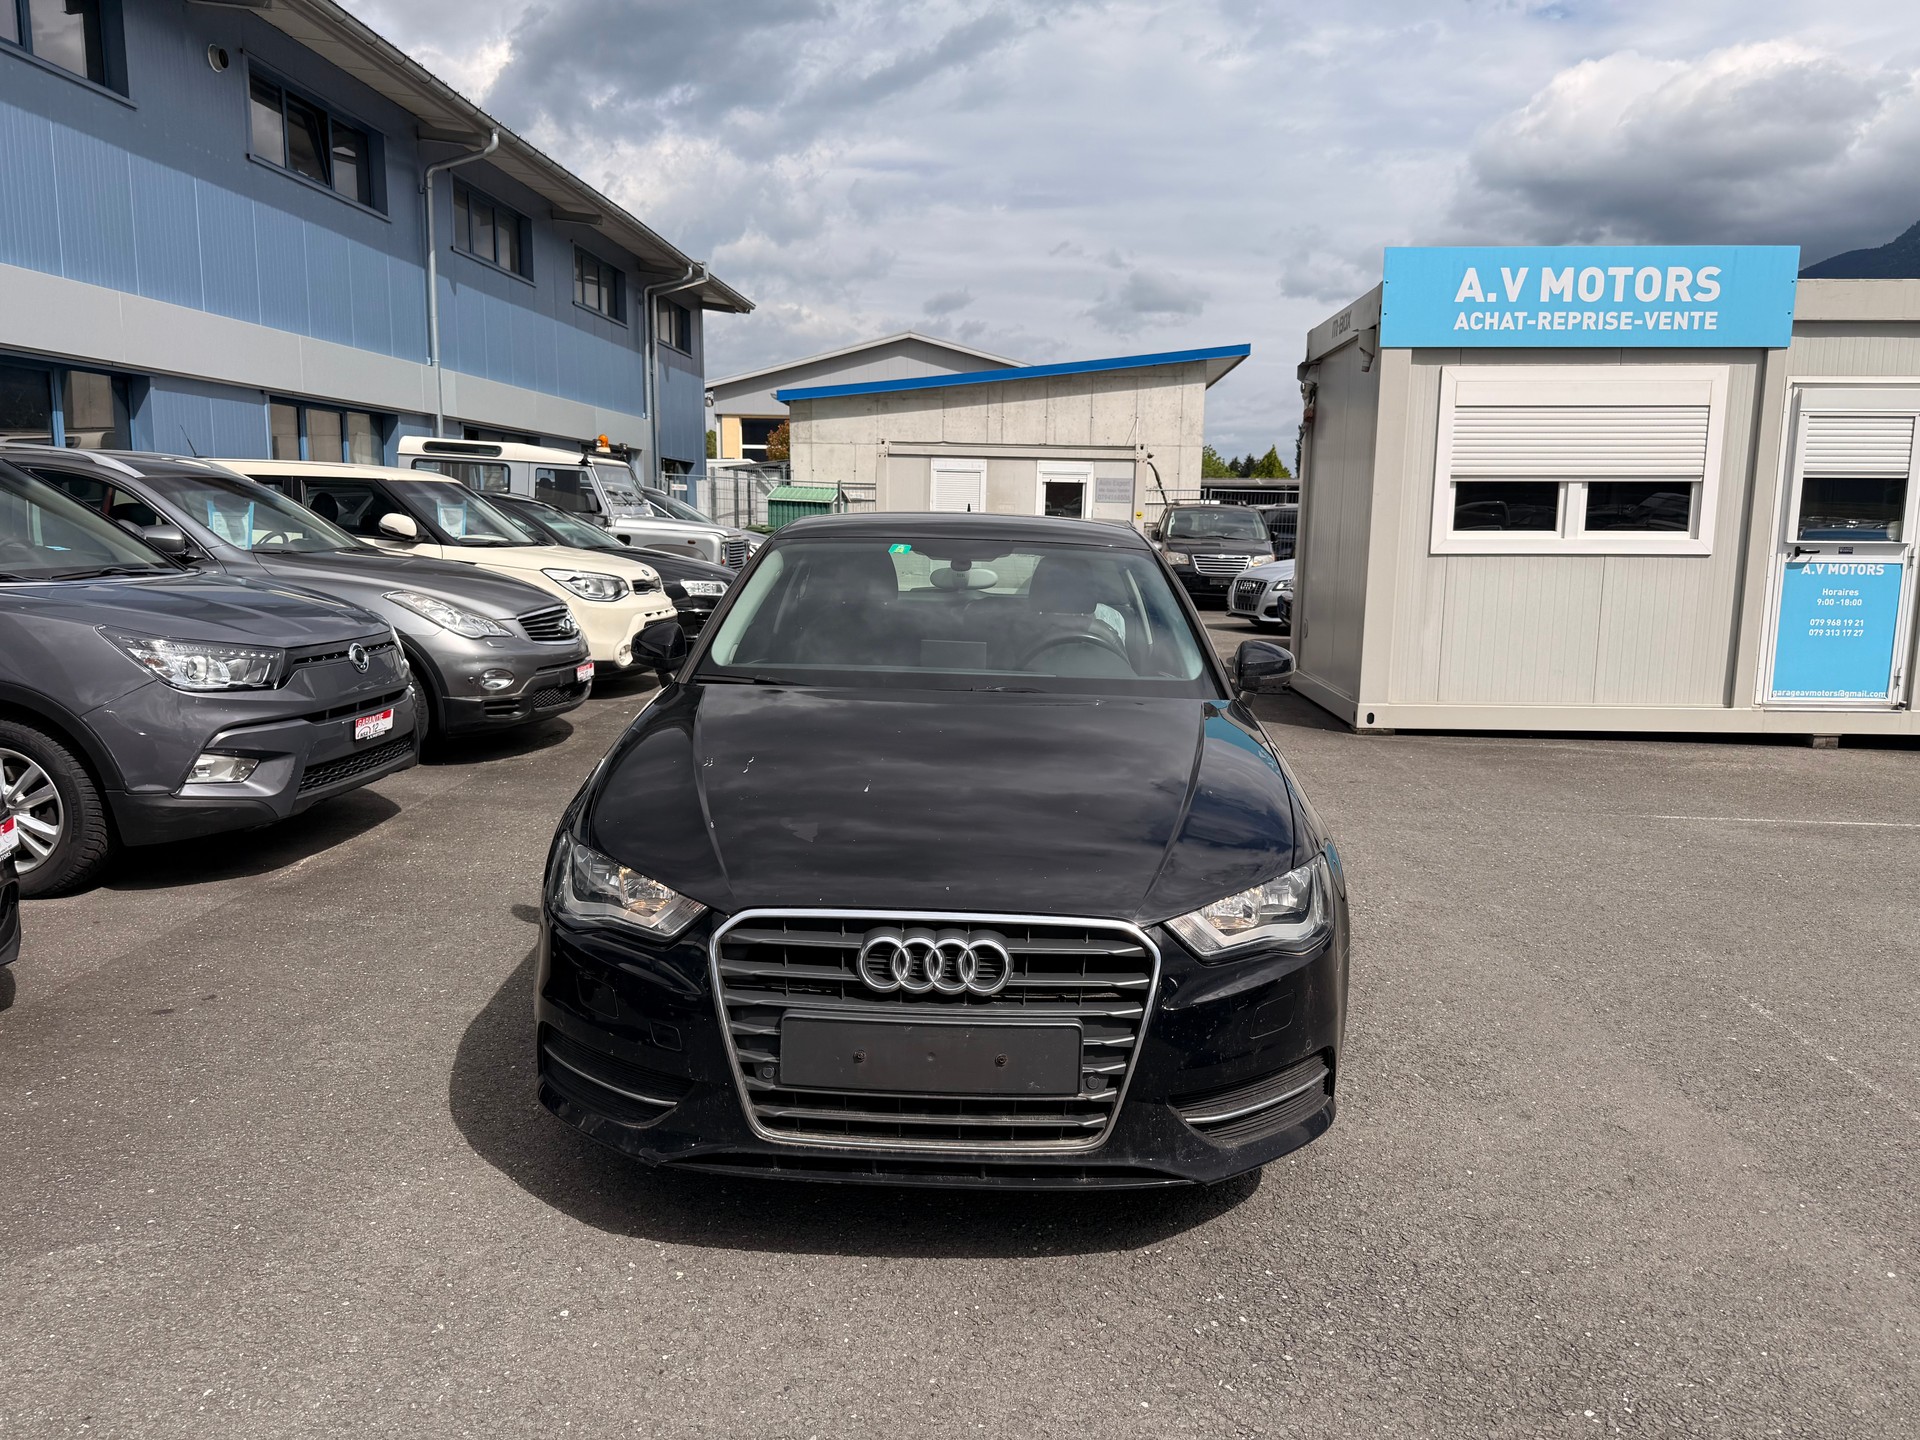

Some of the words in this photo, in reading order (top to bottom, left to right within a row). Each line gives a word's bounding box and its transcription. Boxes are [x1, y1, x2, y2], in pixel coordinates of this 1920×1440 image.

[1454, 267, 1529, 302] A.V
[1539, 266, 1721, 302] MOTORS
[1453, 311, 1718, 331] ACHAT-REPRISE-VENTE
[1801, 564, 1826, 575] A.V
[1828, 564, 1885, 575] MOTORS
[1822, 588, 1859, 596] Horaires
[1816, 598, 1835, 606] 9:00
[1809, 618, 1825, 627] 079
[1826, 618, 1841, 627] 968
[1843, 619, 1853, 627] 19
[1854, 619, 1864, 627] 21
[1808, 629, 1824, 637] 079
[1825, 629, 1840, 637] 313
[1842, 629, 1852, 637] 17
[1853, 629, 1864, 637] 27
[1772, 689, 1887, 698] garageavmotors@gmail.com
